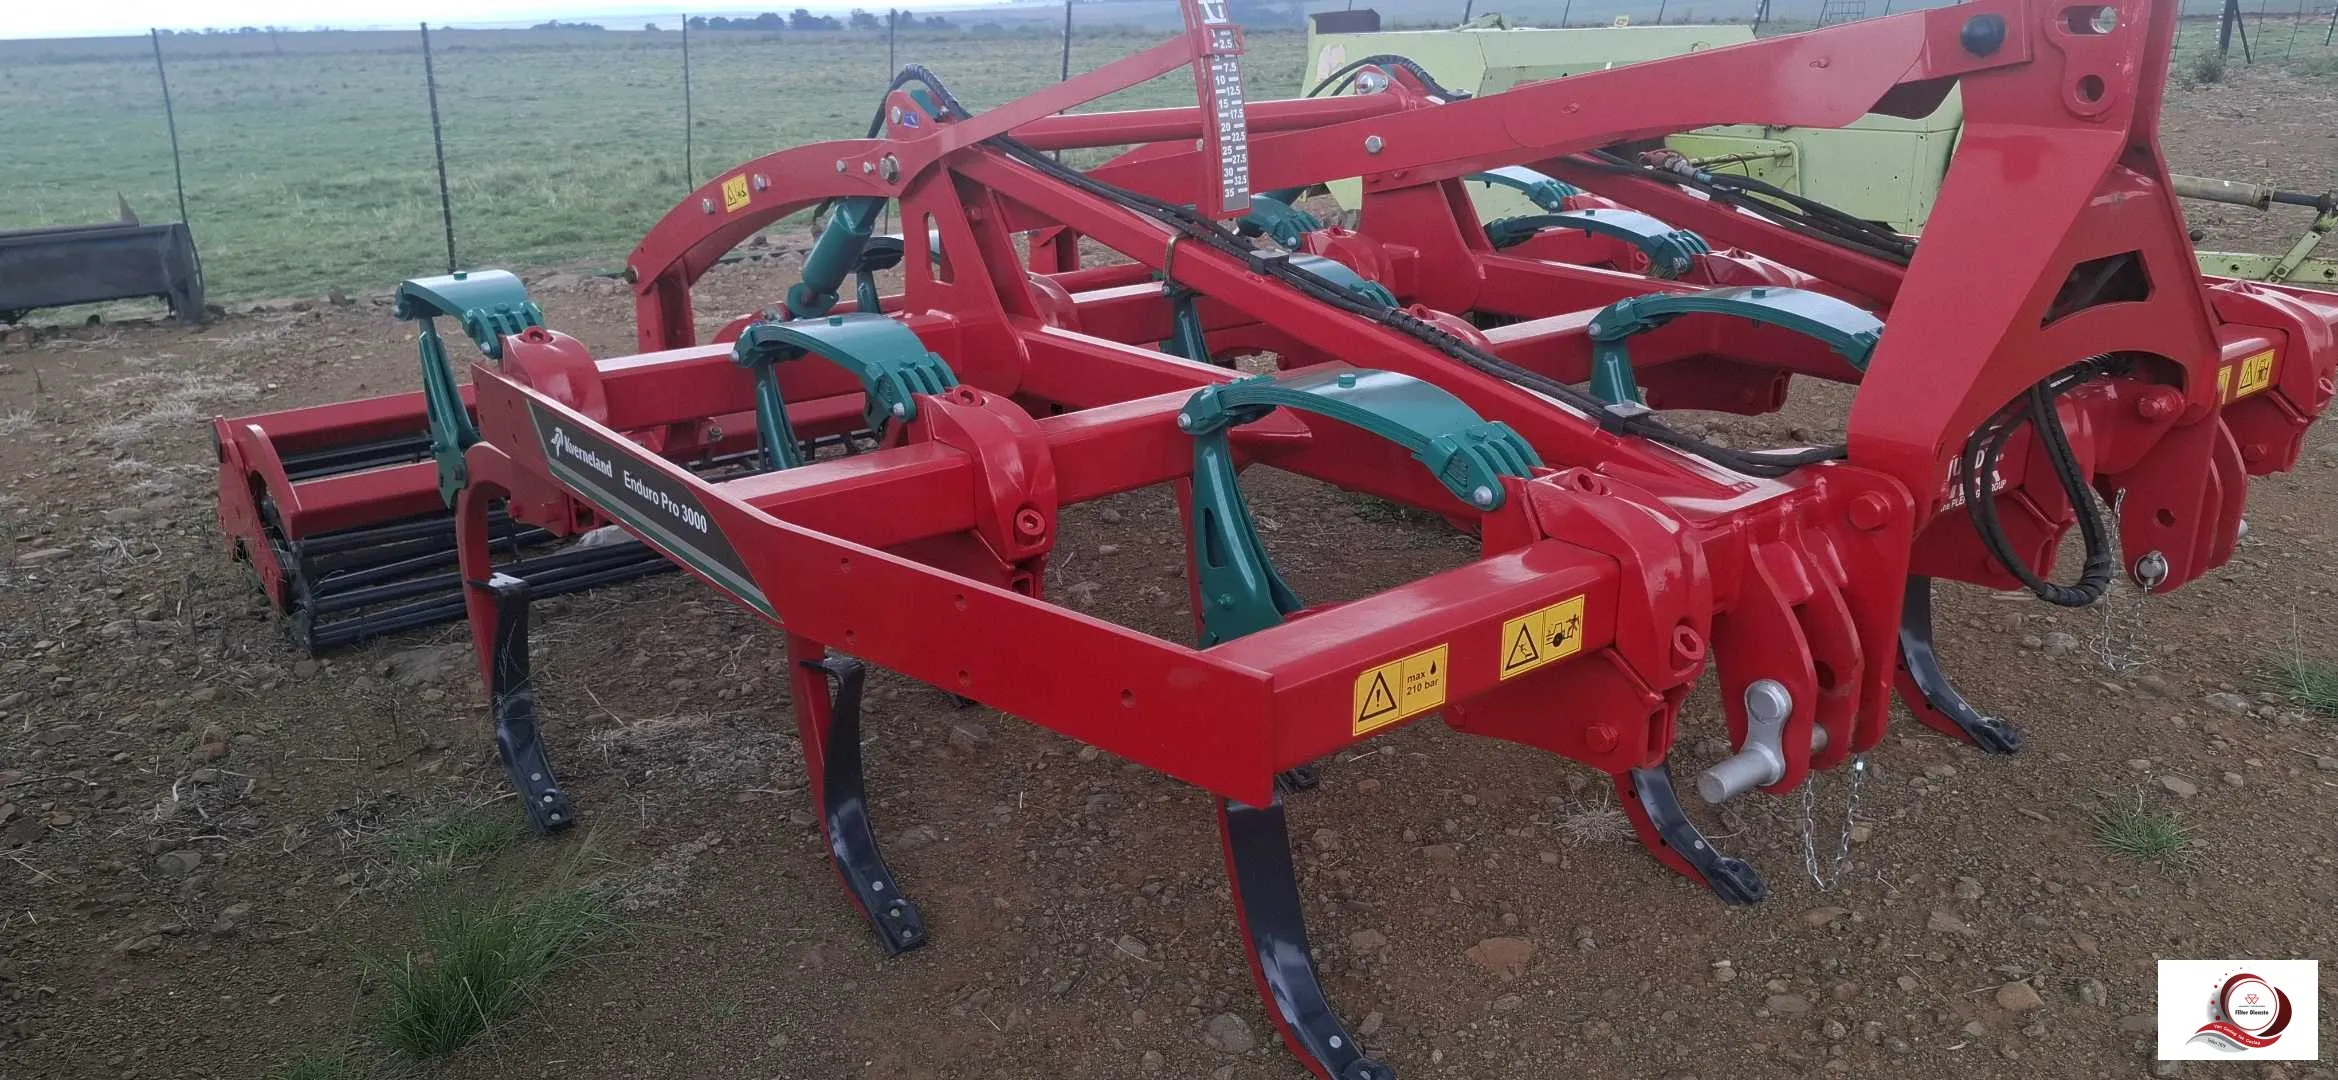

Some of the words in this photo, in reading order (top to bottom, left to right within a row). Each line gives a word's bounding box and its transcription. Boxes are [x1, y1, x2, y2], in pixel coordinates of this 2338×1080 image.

[1219, 39, 1233, 49] 2.5
[1223, 62, 1237, 72] 7.5
[1215, 75, 1226, 85] 10
[1226, 86, 1241, 96] 12.5
[1219, 98, 1229, 109] 15
[1230, 109, 1244, 119] 17.5
[1221, 122, 1231, 132] 20
[1231, 131, 1246, 141] 22.5
[1222, 146, 1232, 155] 25
[1232, 154, 1247, 164] 27.5
[1223, 167, 1234, 177] 30
[1234, 175, 1247, 185] 32.5
[1224, 188, 1234, 198] 35
[564, 436, 612, 478] Kverneland
[623, 470, 659, 506] Enduro
[661, 491, 680, 518] Pro
[681, 504, 708, 535] 3000
[1407, 671, 1426, 683] max
[1406, 683, 1422, 695] 210
[1424, 678, 1439, 689] bar
